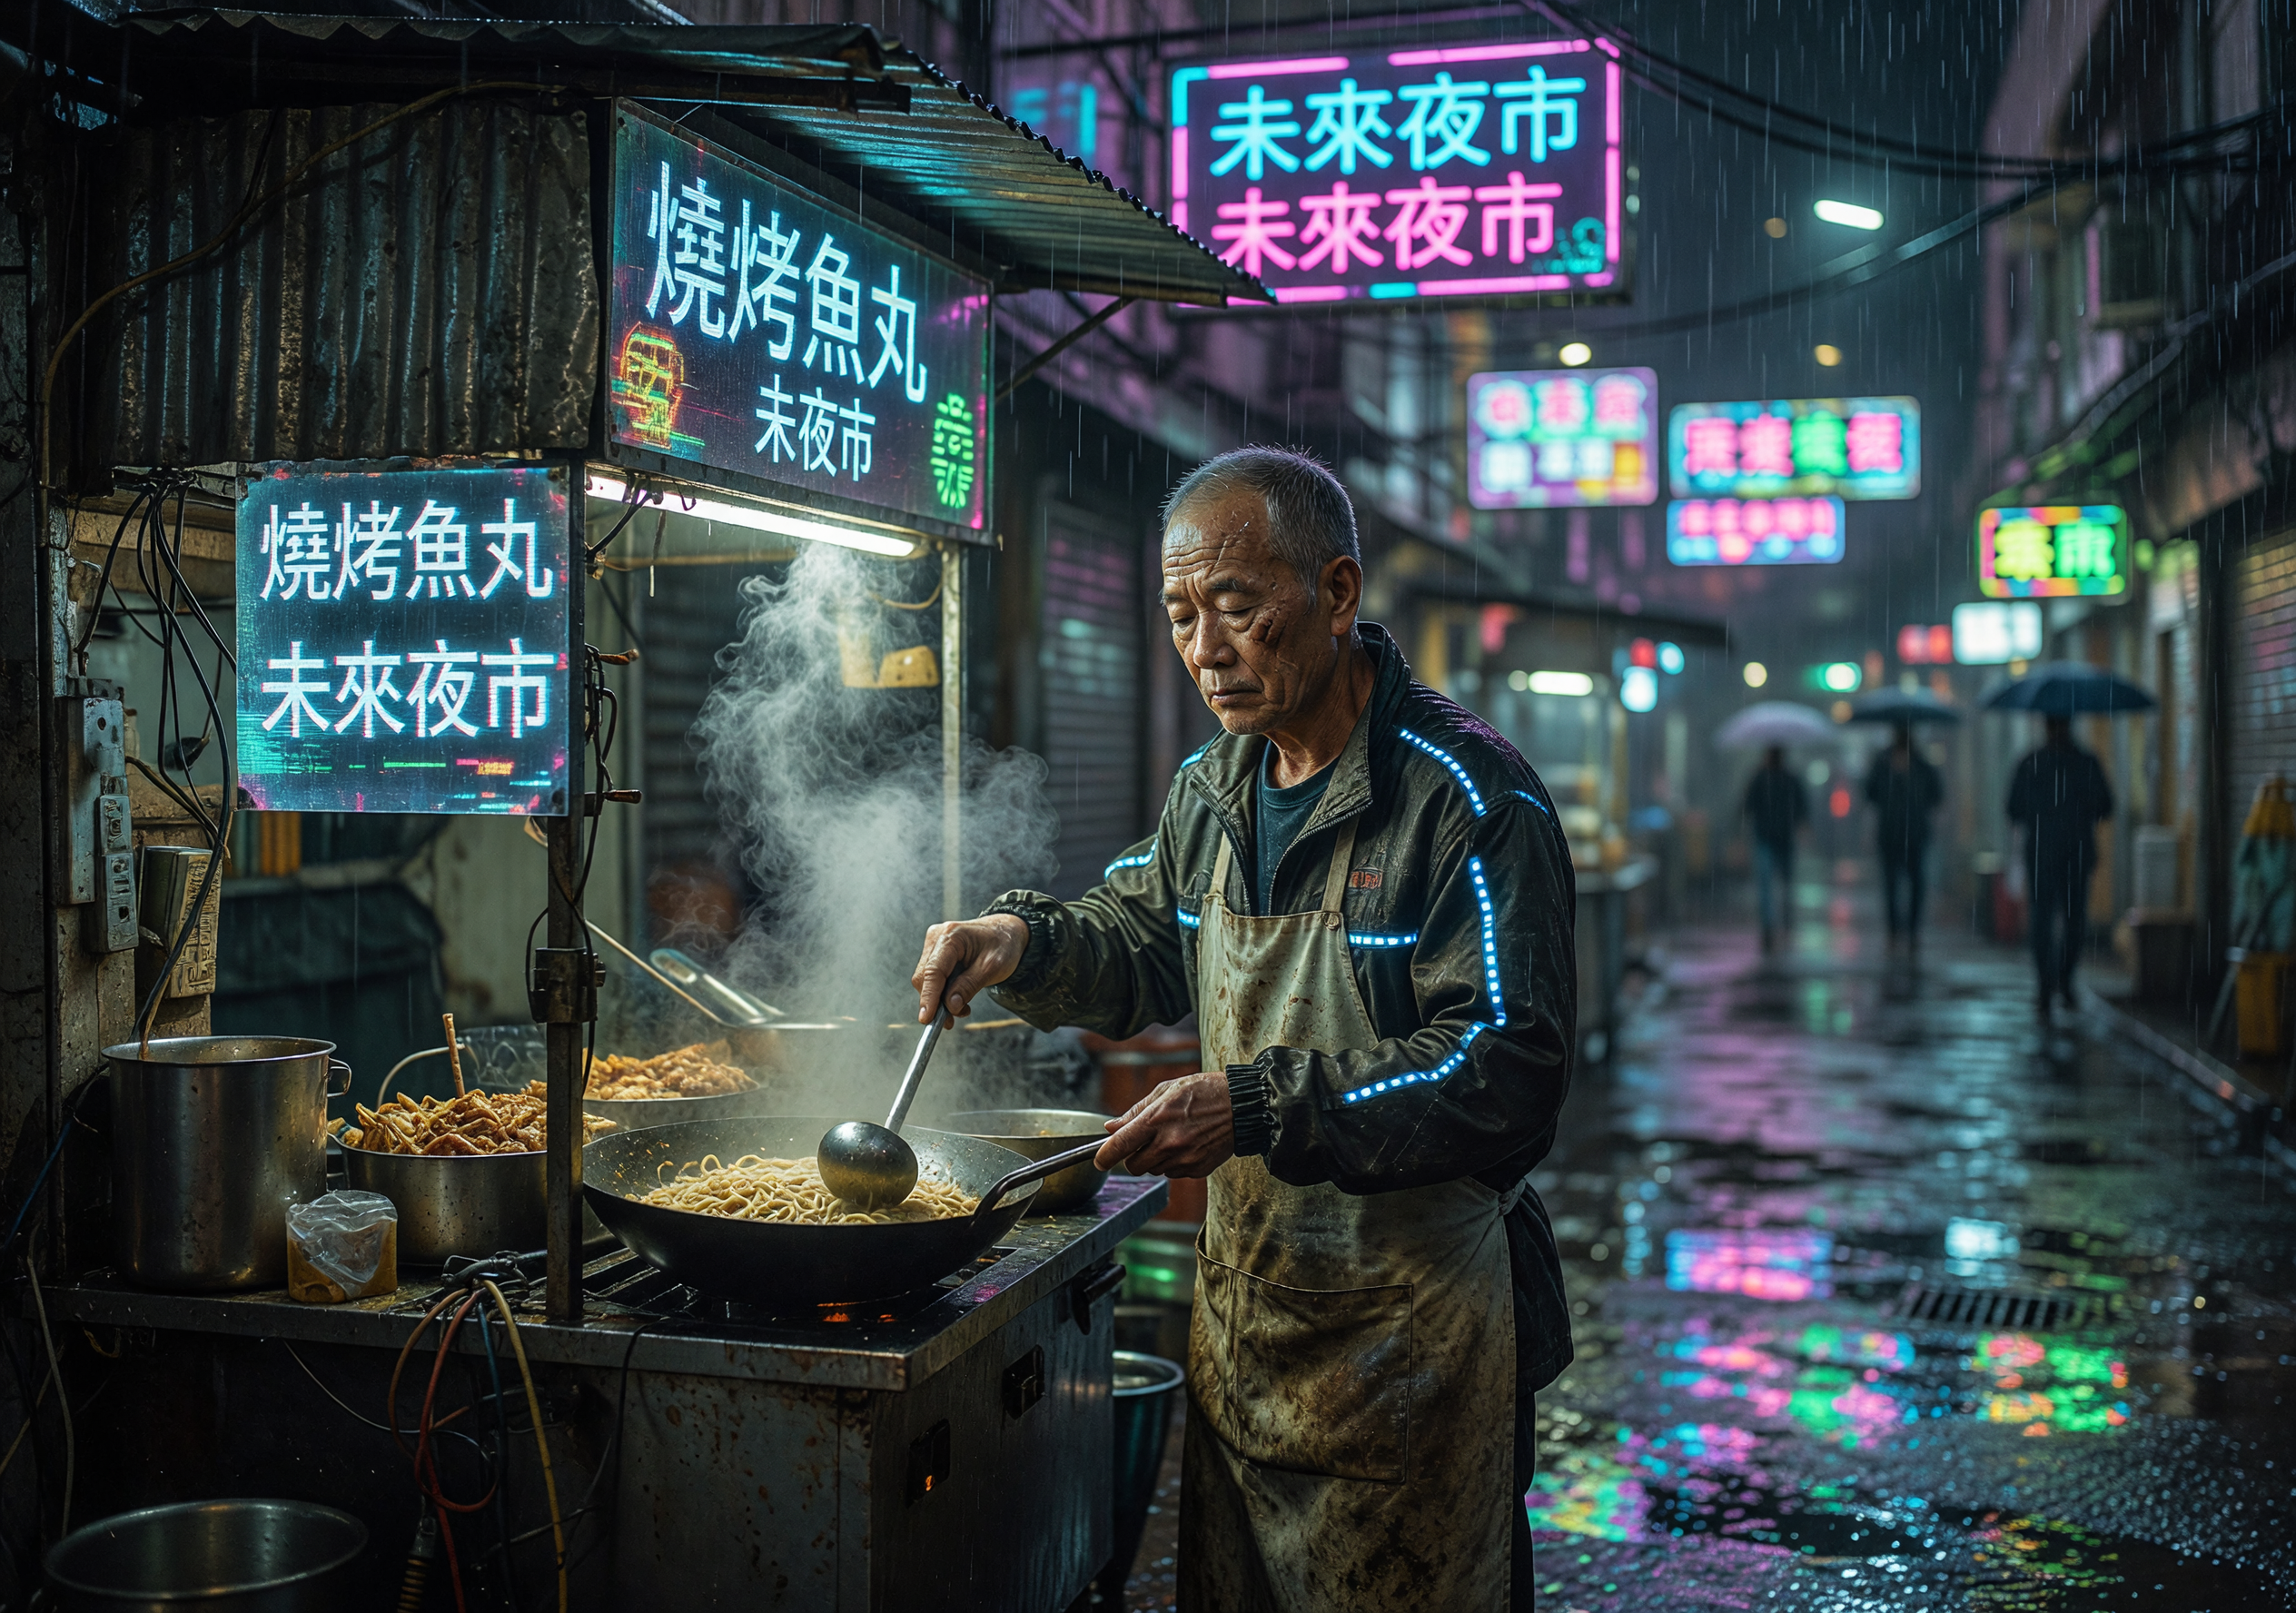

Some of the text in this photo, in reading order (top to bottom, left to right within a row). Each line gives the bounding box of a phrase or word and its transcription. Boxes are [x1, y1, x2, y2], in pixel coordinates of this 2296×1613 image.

[1209, 64, 1587, 181] 未來夜市
[1211, 171, 1563, 276] 未來夜市
[645, 160, 929, 404] 燒烤魚丸
[754, 373, 877, 482] 未夜市
[259, 498, 554, 601] 燒烤魚丸
[260, 637, 556, 739] 未來夜市
